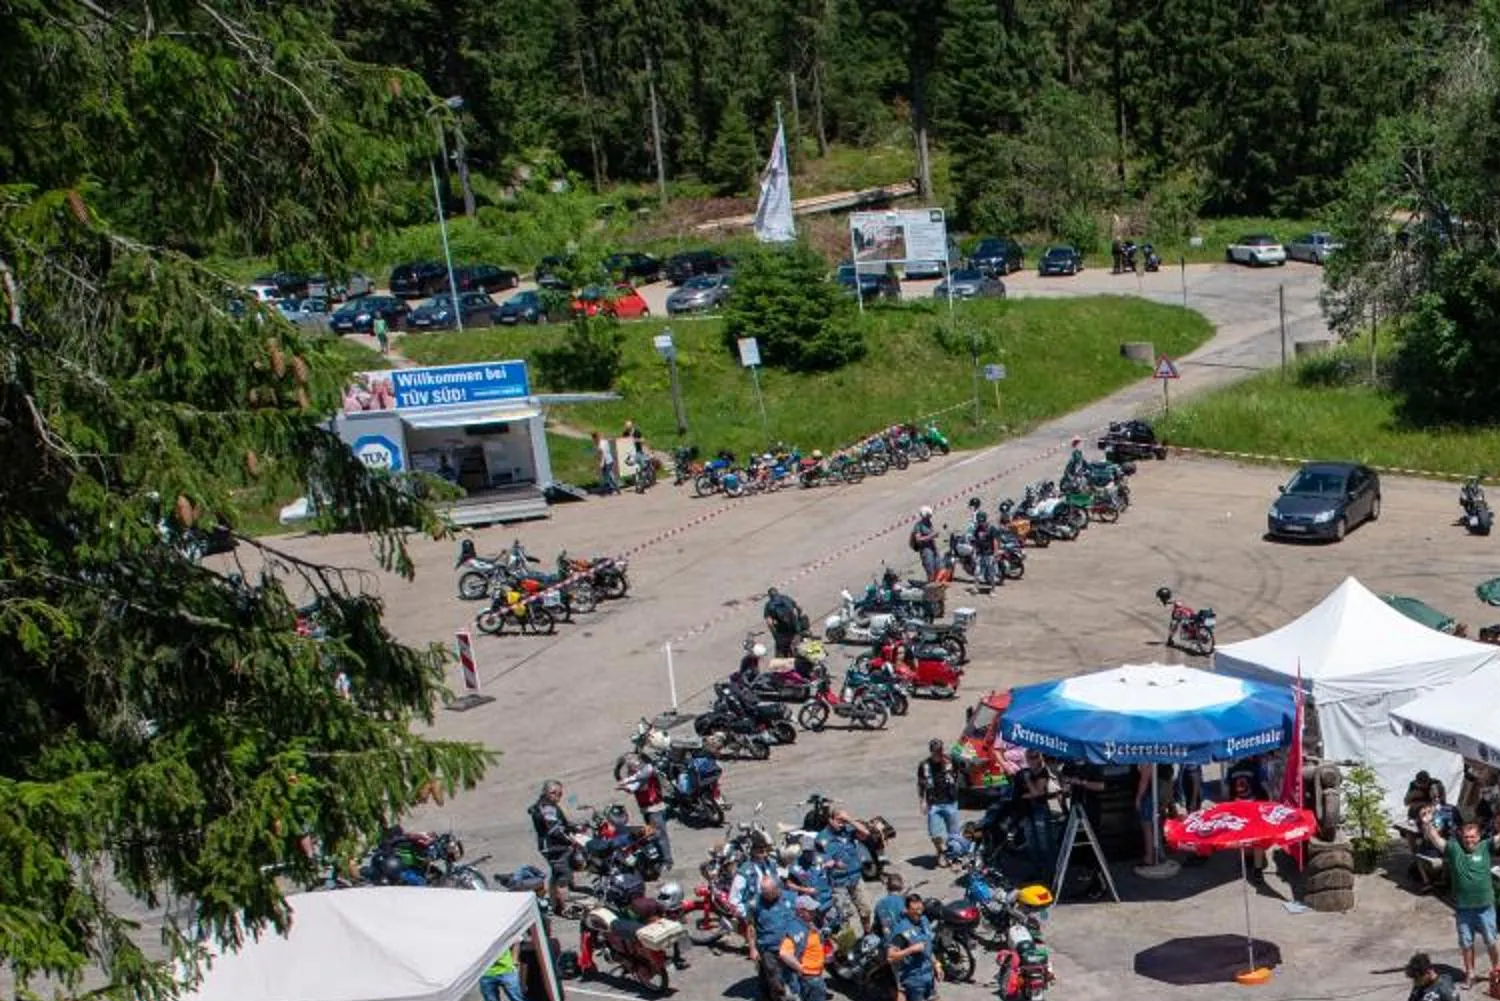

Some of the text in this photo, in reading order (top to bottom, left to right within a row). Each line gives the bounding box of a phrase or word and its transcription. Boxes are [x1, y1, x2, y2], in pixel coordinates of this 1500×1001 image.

[397, 366, 507, 387] Willkommen bei
[401, 389, 433, 406] TÜV
[433, 388, 467, 404] SÜD!
